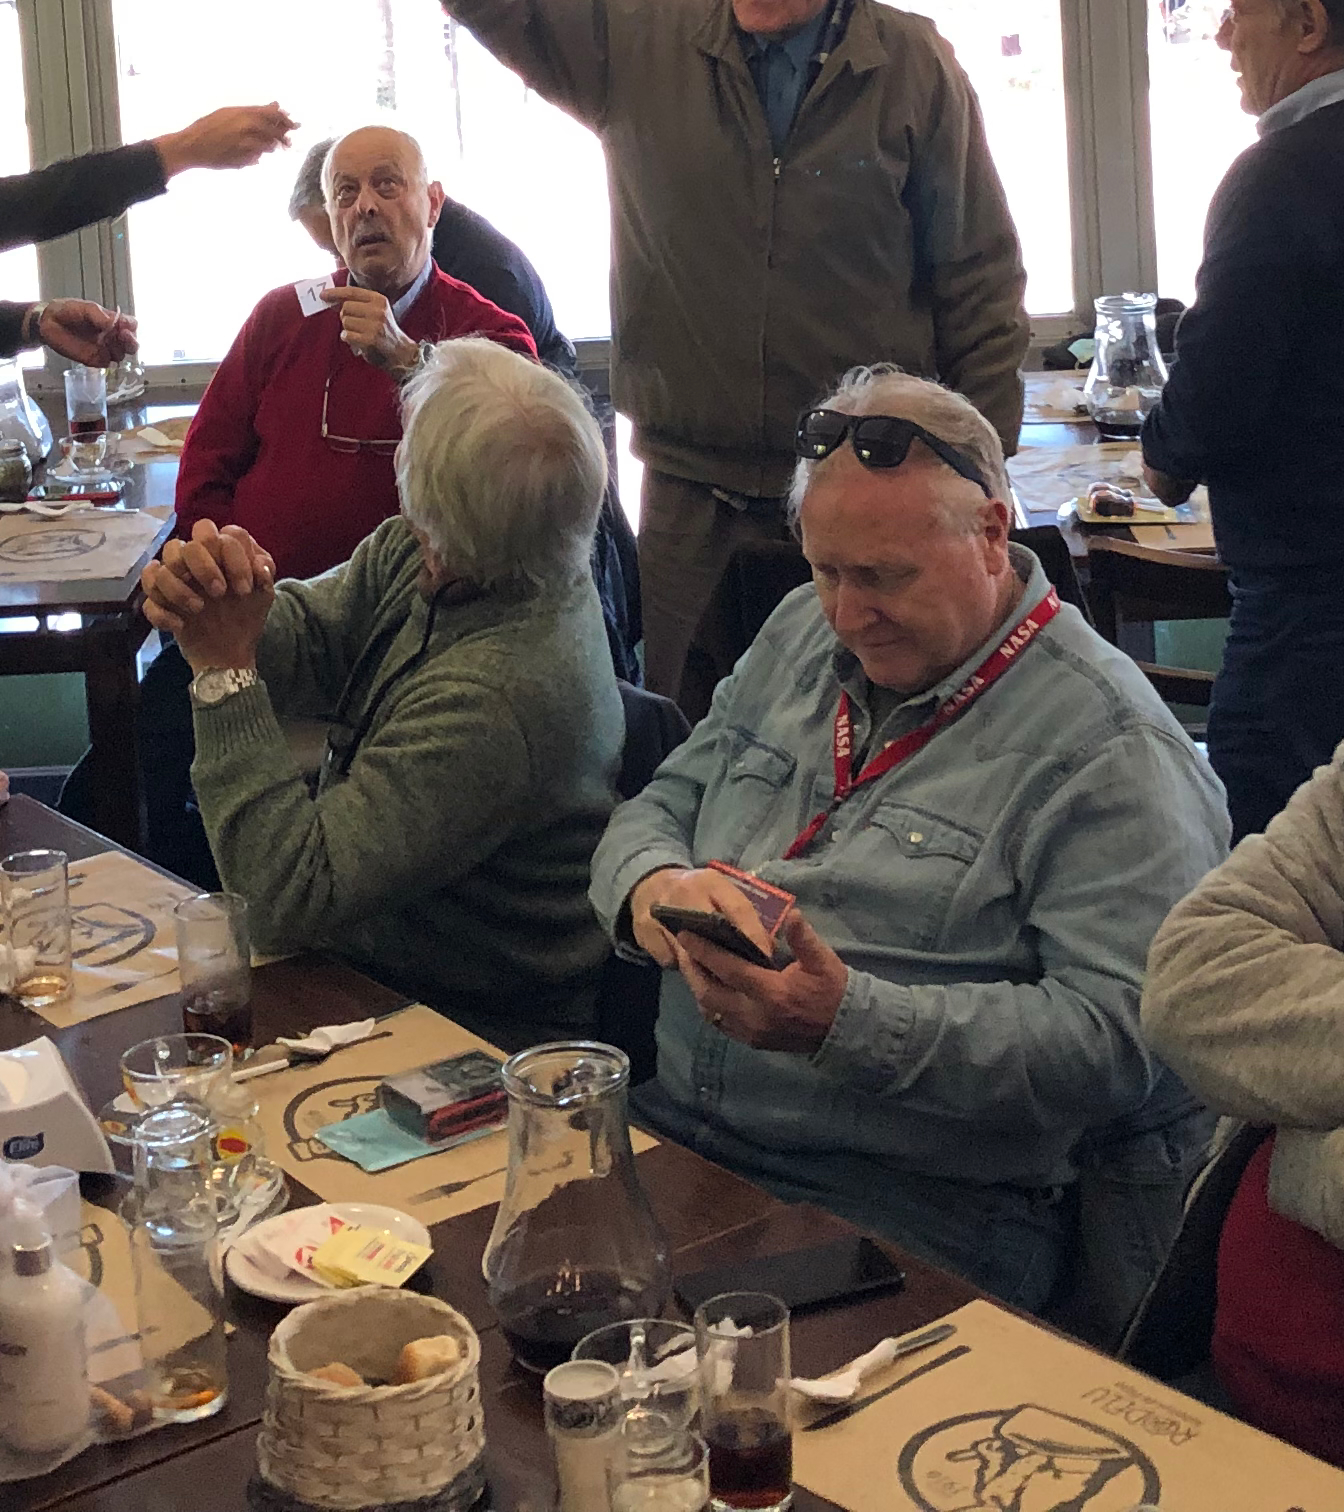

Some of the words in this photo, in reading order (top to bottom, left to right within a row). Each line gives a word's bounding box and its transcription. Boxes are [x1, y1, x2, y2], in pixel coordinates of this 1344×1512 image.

[999, 618, 1040, 659] NASA
[941, 675, 985, 716] NASA
[836, 714, 851, 758] NASA
